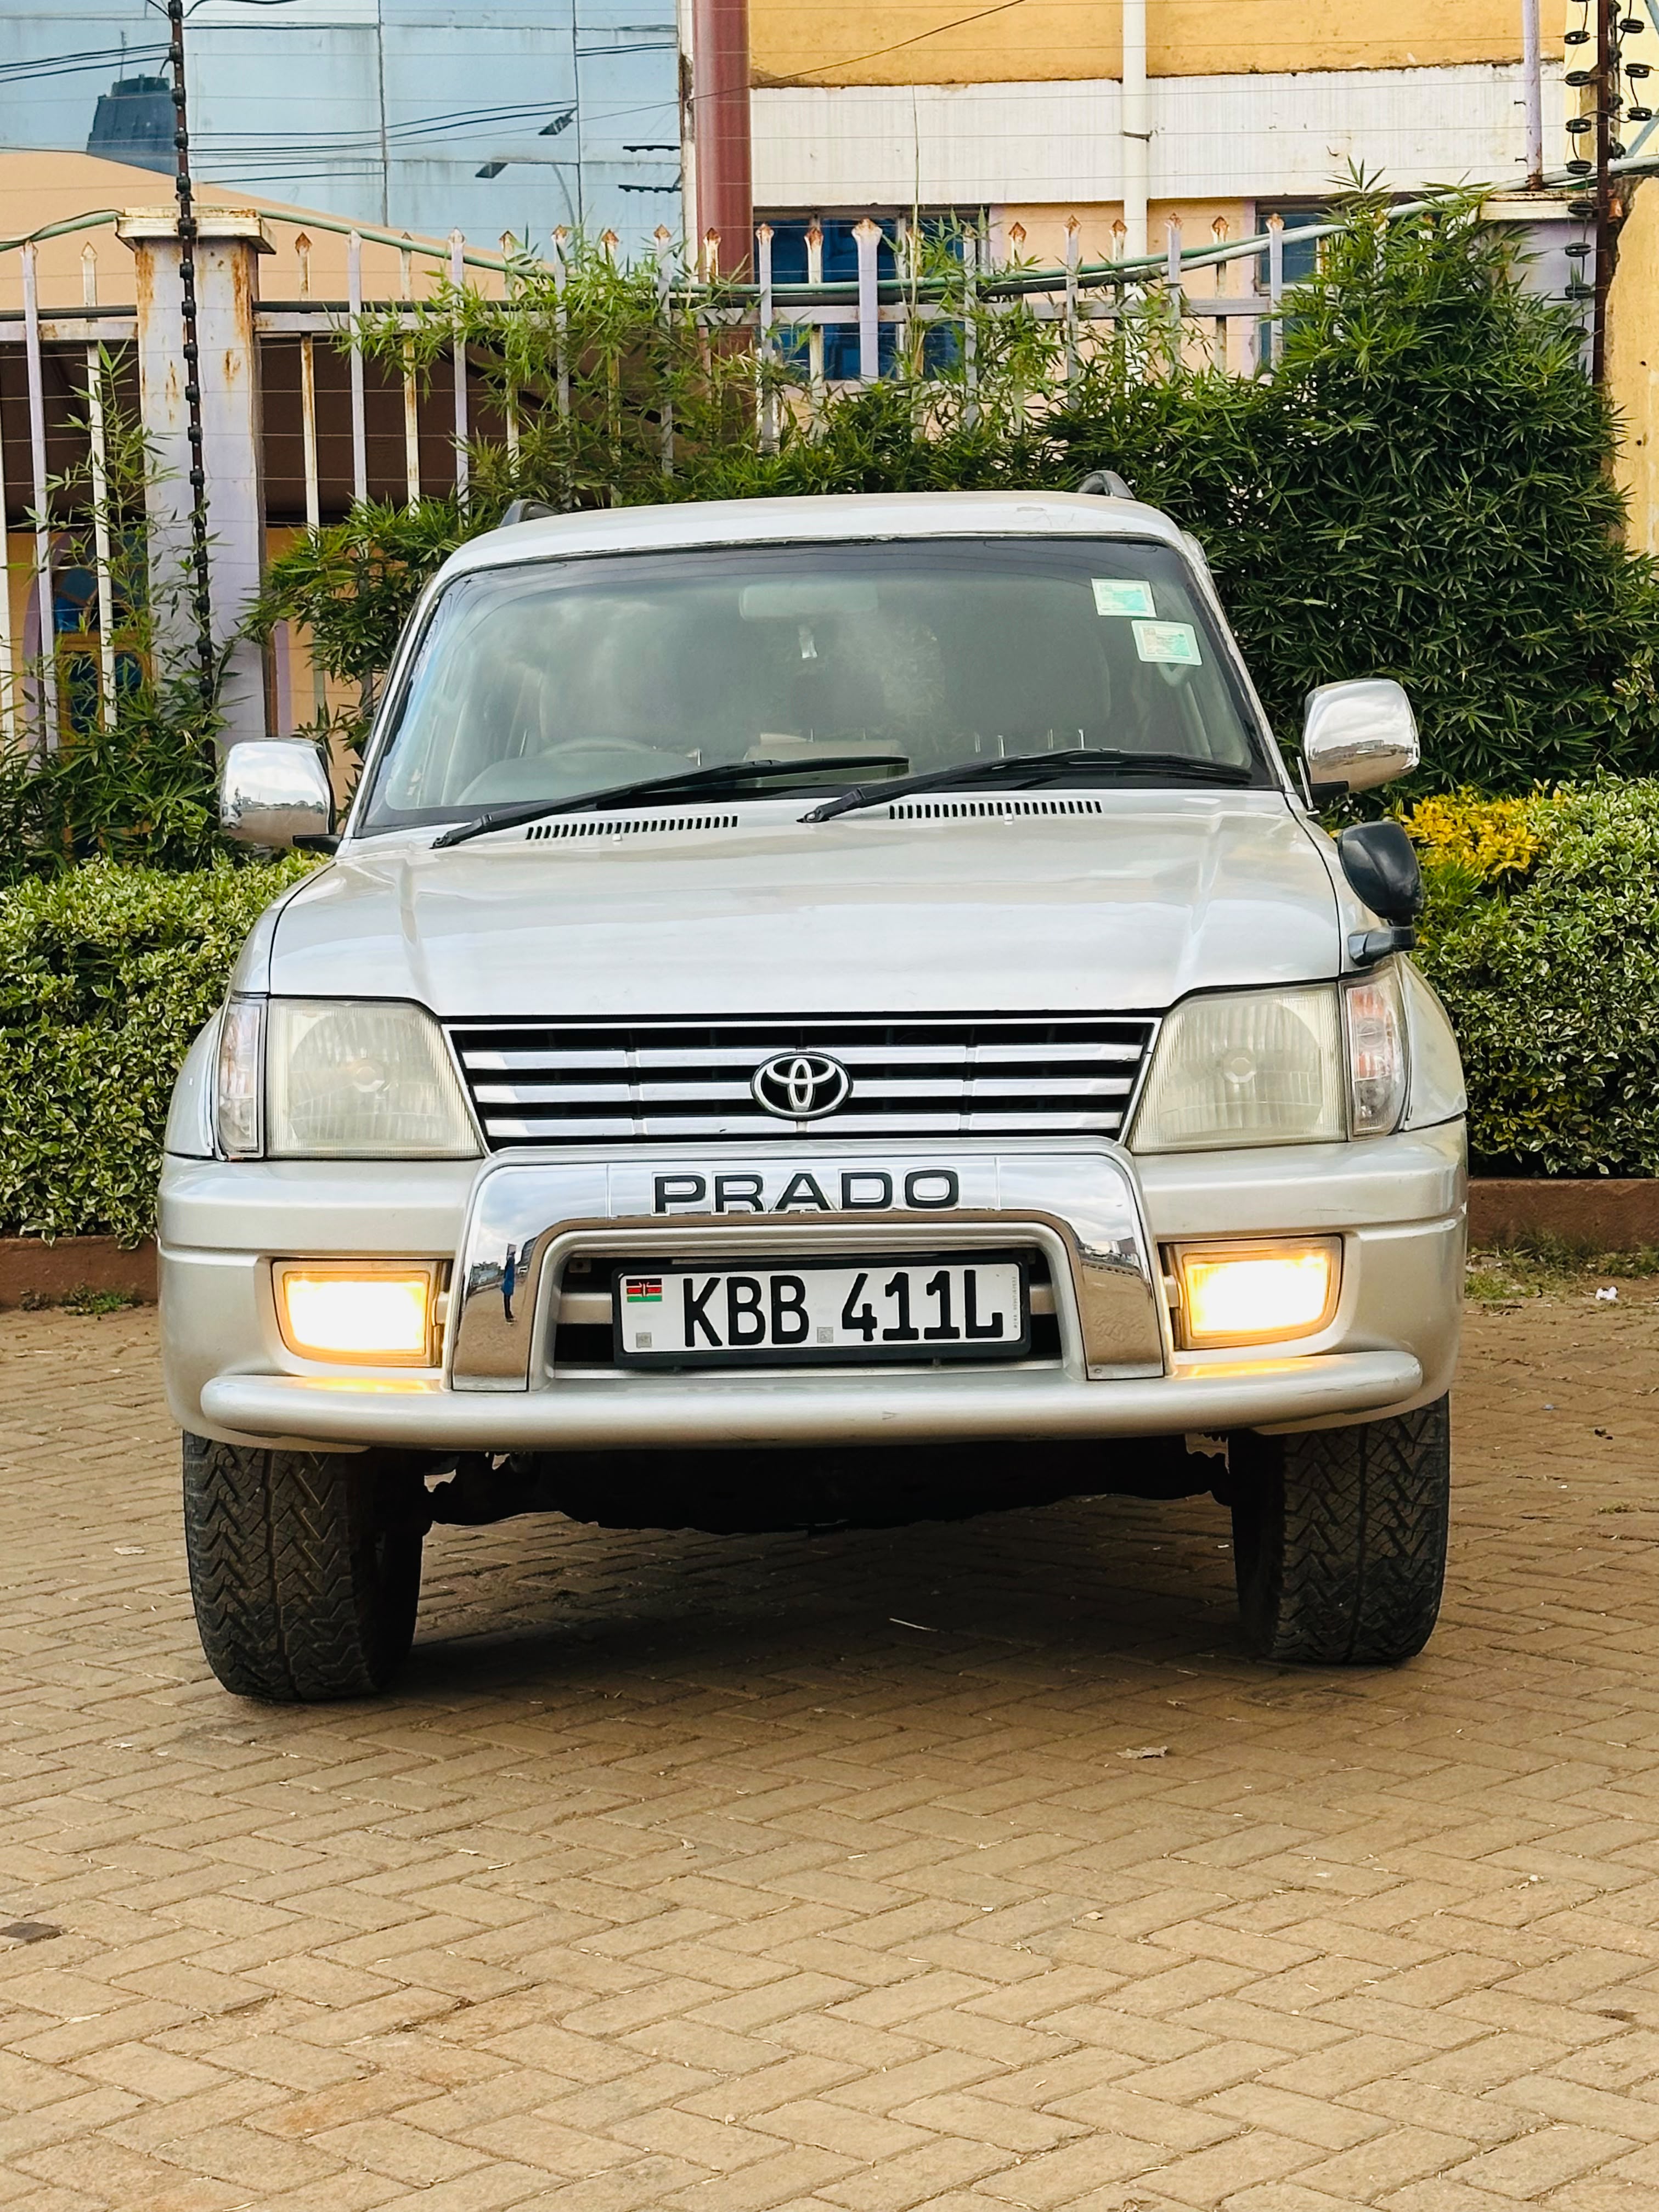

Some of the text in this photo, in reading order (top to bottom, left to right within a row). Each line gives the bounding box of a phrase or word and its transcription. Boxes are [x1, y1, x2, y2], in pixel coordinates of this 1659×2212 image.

[653, 1169, 959, 1213] PRADO
[682, 1274, 809, 1347] KBB
[841, 1269, 1003, 1341] 411L
